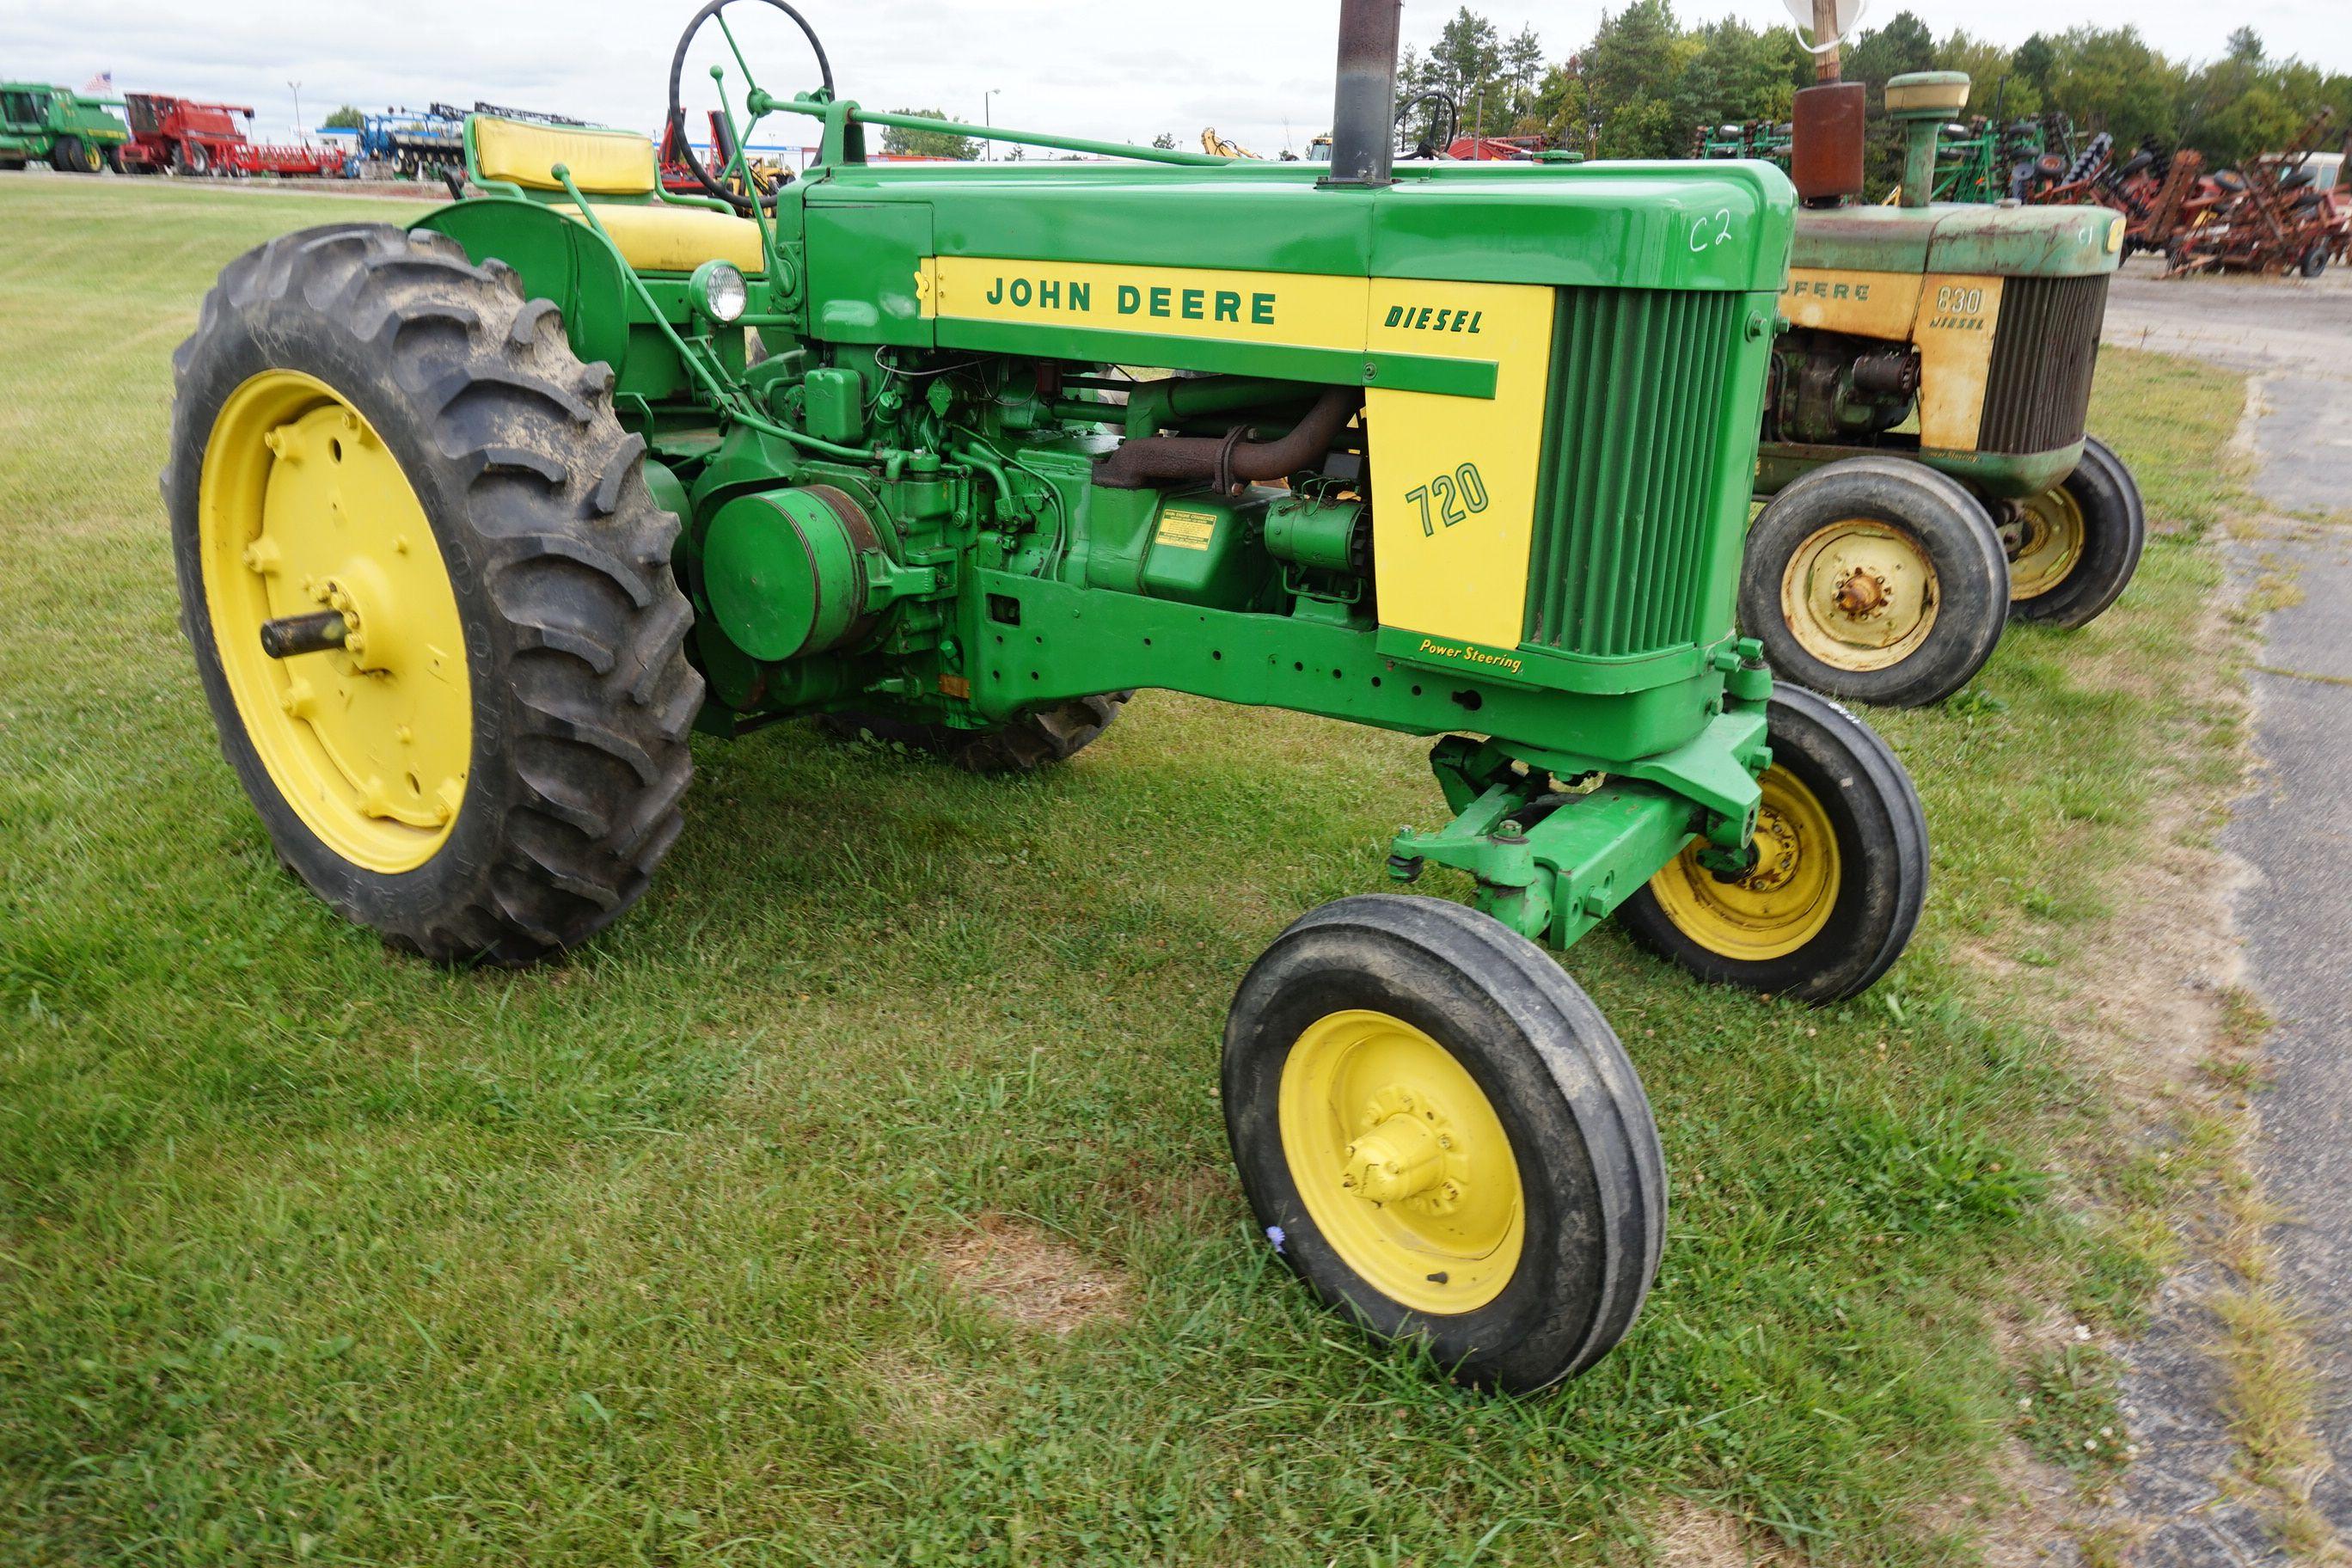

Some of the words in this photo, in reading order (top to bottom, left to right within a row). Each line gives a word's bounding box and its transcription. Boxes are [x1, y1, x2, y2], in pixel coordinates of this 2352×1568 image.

[1689, 208, 1731, 252] C2
[986, 277, 1090, 312] JOHN
[1118, 285, 1276, 325] DEERE
[1384, 305, 1482, 334] DIESEL
[1937, 285, 1982, 315] 830
[1405, 462, 1490, 537] 720
[1419, 639, 1462, 658] Power
[1464, 646, 1522, 673] Steering
